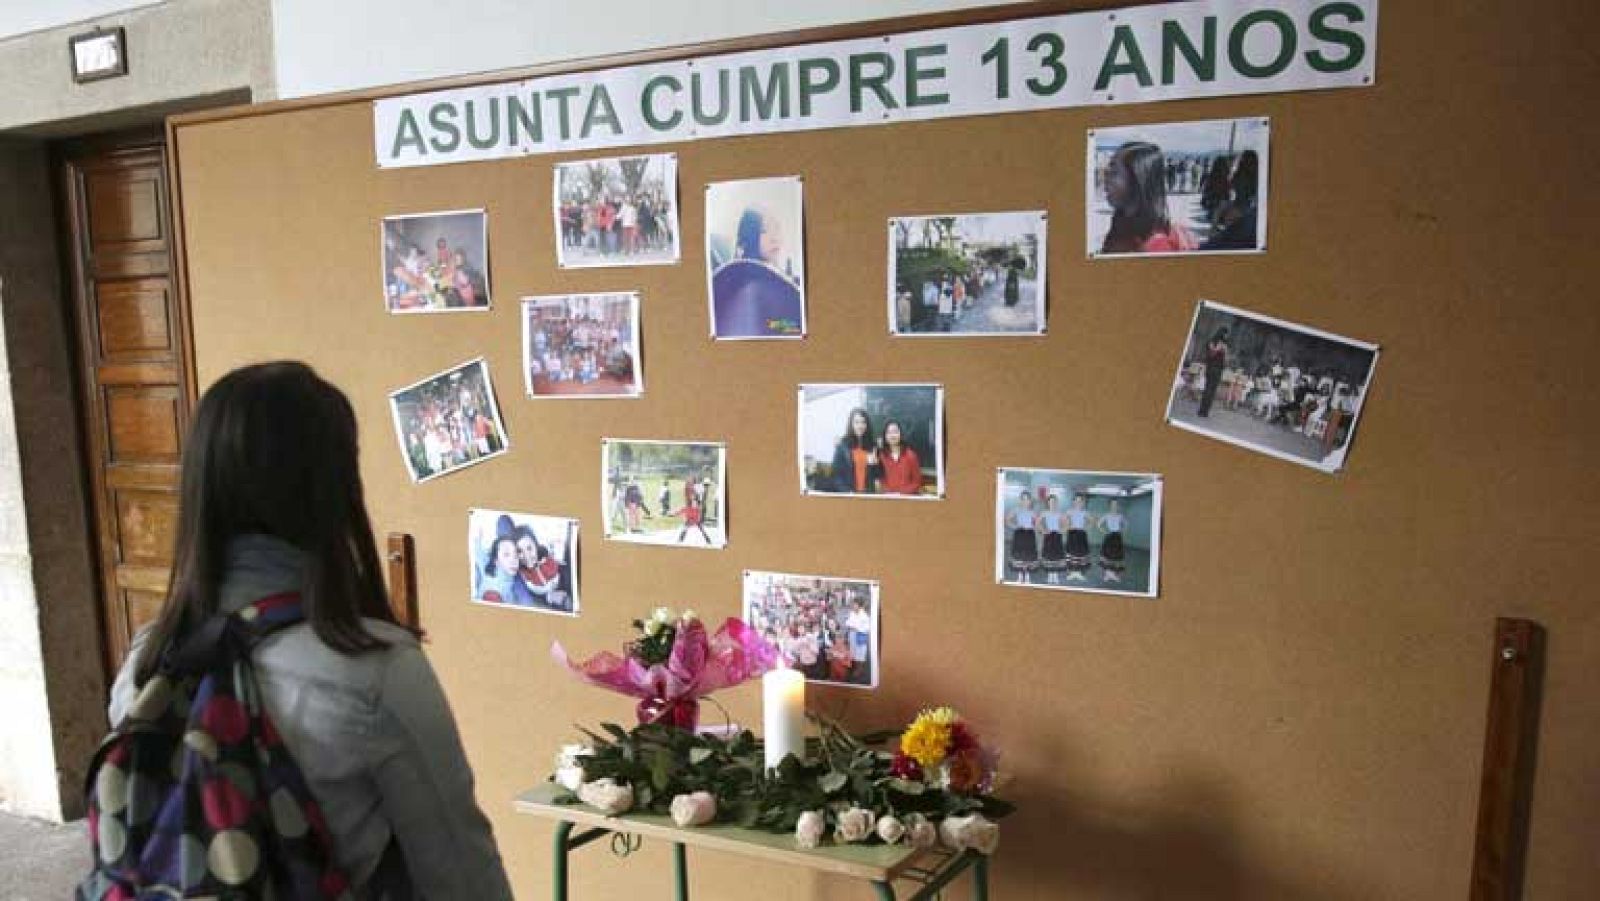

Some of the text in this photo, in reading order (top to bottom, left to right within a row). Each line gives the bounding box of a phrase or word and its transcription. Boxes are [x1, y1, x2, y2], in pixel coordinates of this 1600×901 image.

[391, 1, 1366, 158] ASUNTA CUMPRE 13 ANOS
